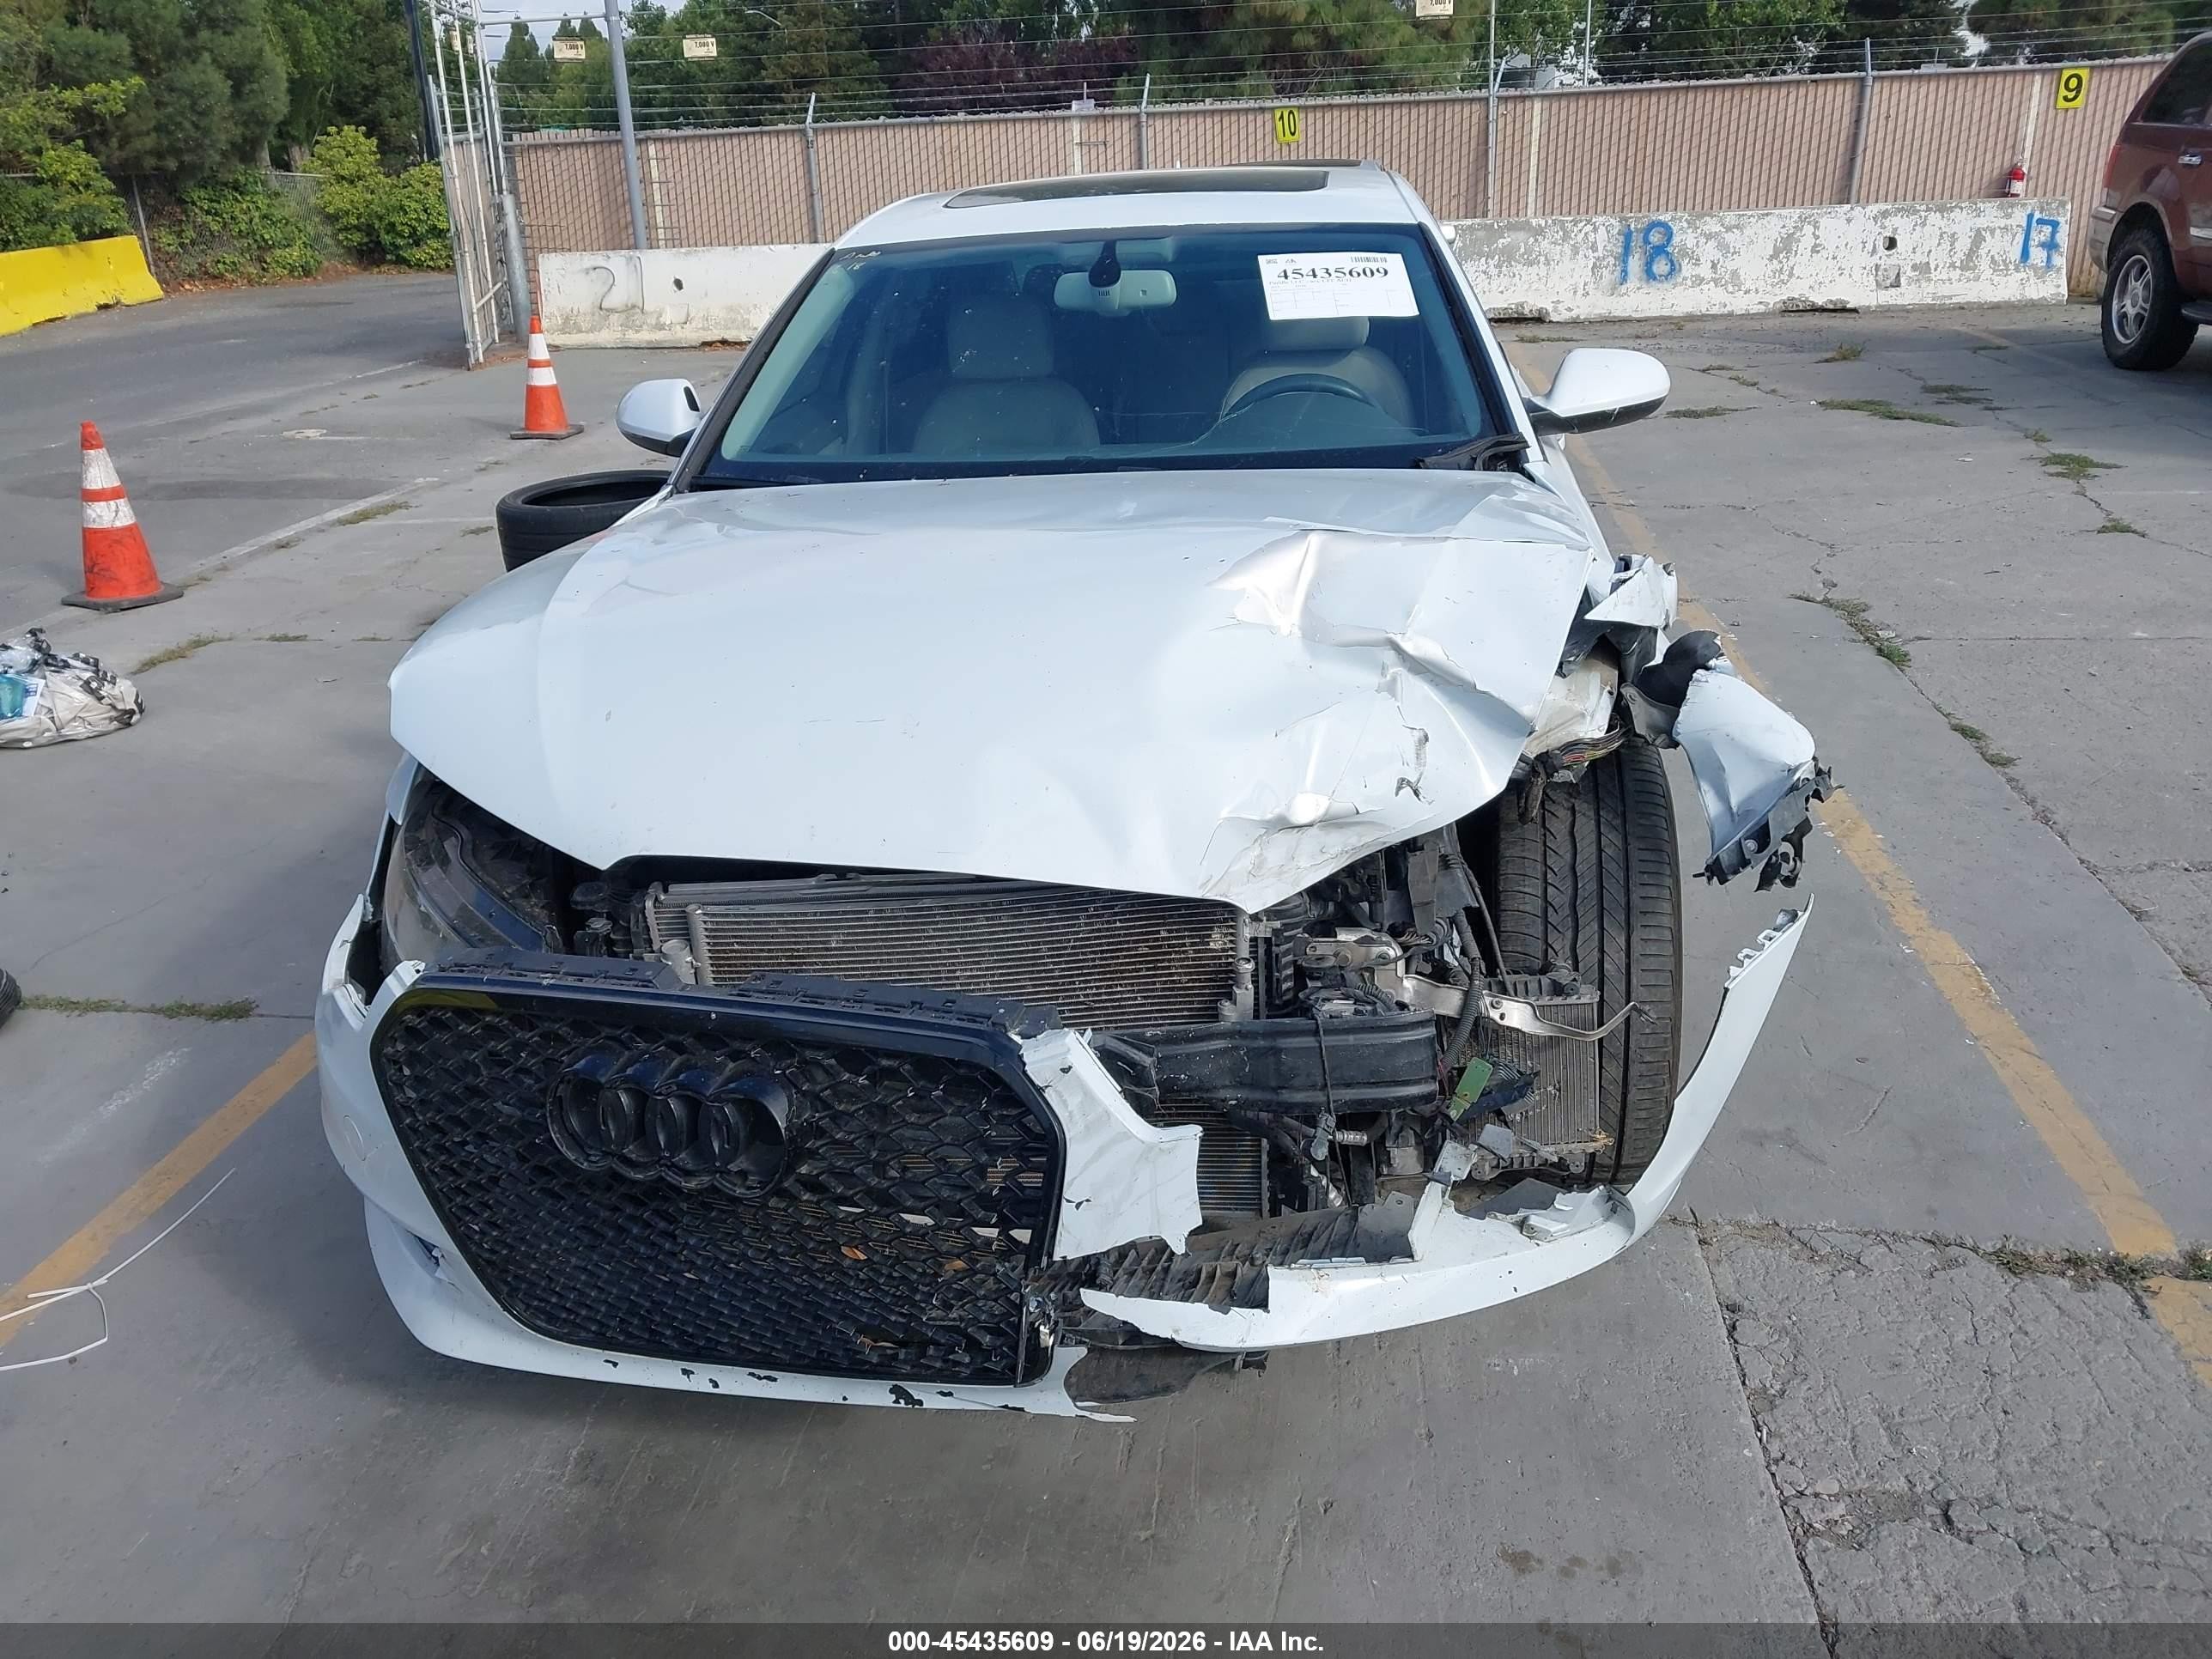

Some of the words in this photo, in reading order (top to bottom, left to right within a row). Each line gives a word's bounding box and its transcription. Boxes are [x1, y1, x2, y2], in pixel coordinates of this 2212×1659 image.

[2062, 73, 2083, 103] 9
[1278, 109, 1297, 137] 10
[1620, 220, 1676, 285] 18
[2020, 212, 2060, 269] 17
[1277, 266, 1389, 280] 45435609
